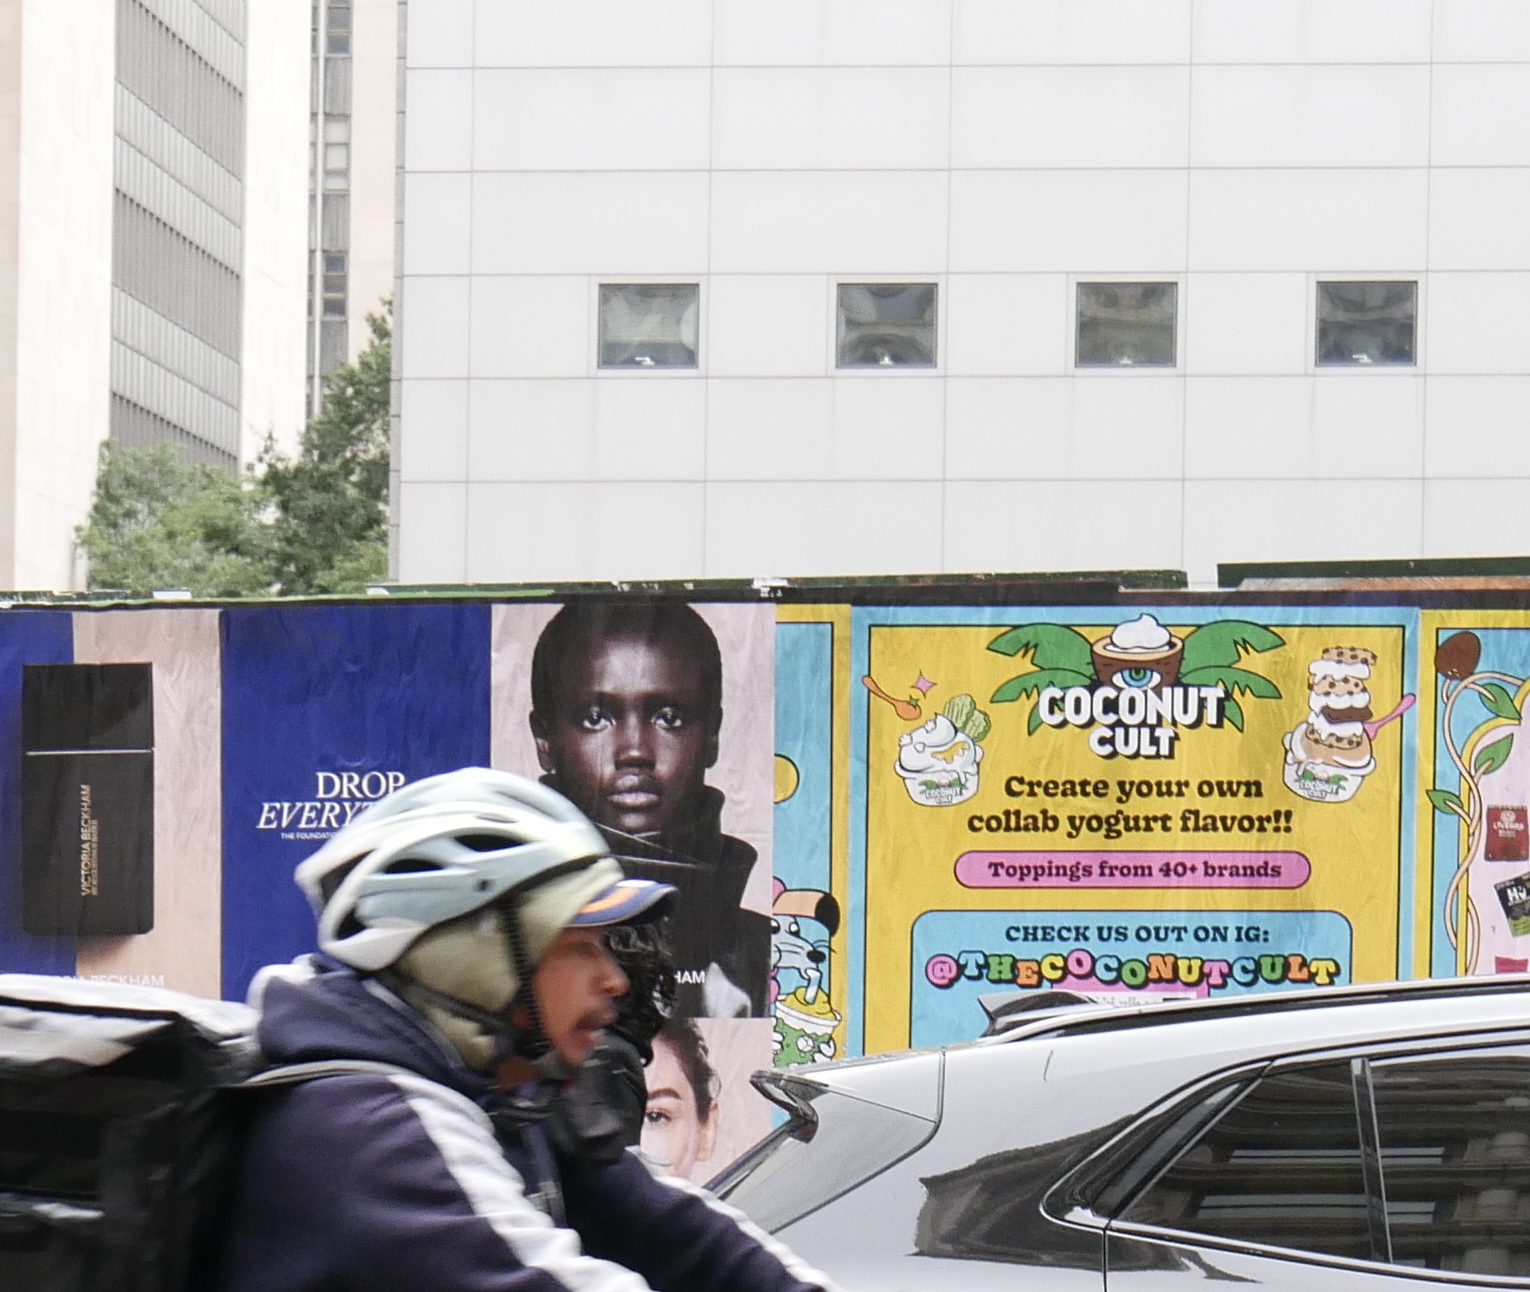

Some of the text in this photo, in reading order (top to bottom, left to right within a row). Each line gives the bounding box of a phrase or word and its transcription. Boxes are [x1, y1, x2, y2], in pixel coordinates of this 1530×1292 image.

[1037, 685, 1229, 728] COCONUT
[1088, 726, 1180, 759] CULT
[316, 771, 406, 799] DROP
[1004, 775, 1263, 803] Create your own
[256, 801, 377, 829] EVERY
[967, 808, 1294, 839] collab yogurt flavor!!
[81, 784, 91, 896] VICTORIA BECKHAM
[281, 832, 295, 840] THE
[988, 860, 1283, 882] Toppings from 40+ brands
[1005, 925, 1270, 943] CHECK US OUT ON IG:
[925, 948, 1341, 989] @THECOCONUTCULT
